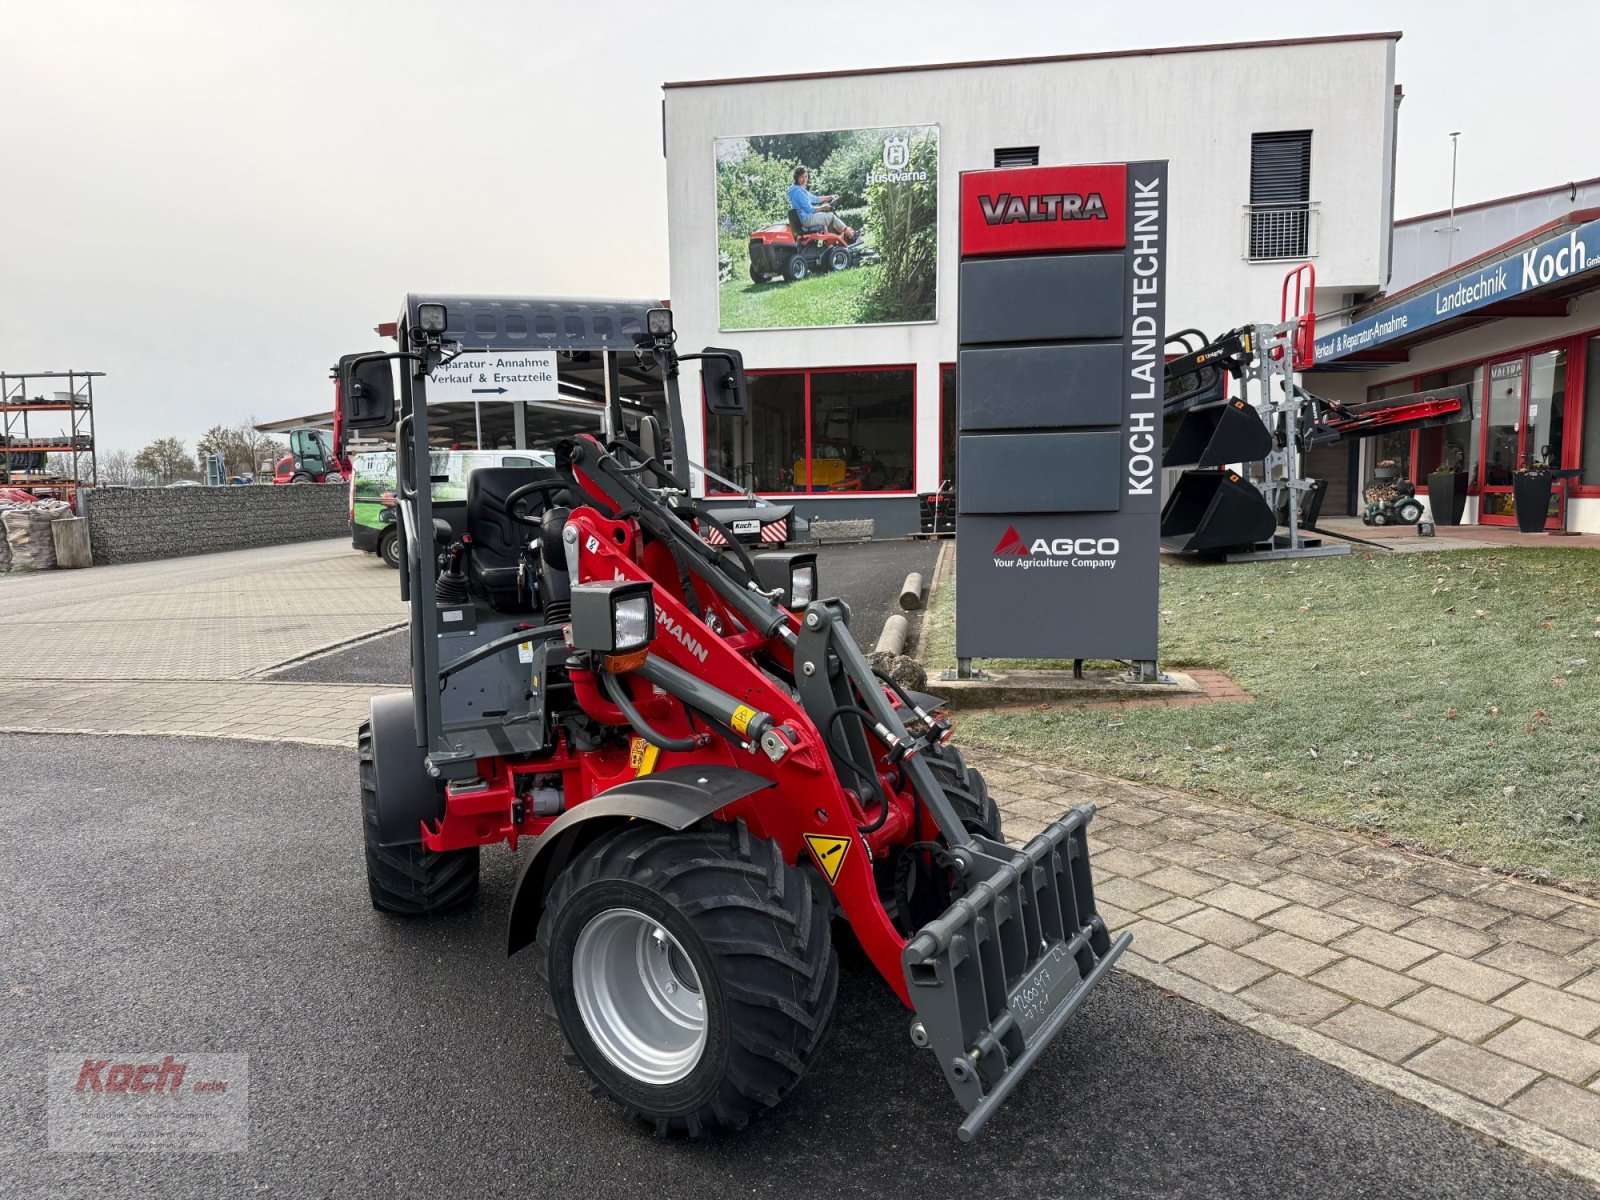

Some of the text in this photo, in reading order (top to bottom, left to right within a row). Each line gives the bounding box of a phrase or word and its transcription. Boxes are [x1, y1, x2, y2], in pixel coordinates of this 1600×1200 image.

[866, 171, 927, 184] Husqvarna
[977, 193, 1108, 226] VALTRA
[1314, 231, 1600, 359] Verkauf & Reparatur-Annahme Landtechnik Koch Gmb
[1128, 177, 1160, 495] KOCH LANDTECHNIK
[434, 359, 486, 372] eparatur
[496, 358, 549, 368] Annahme
[430, 372, 552, 384] Verkauf & Ersatzteile
[1029, 537, 1120, 555] AGCO
[993, 557, 1116, 570] Your Agriculture Company
